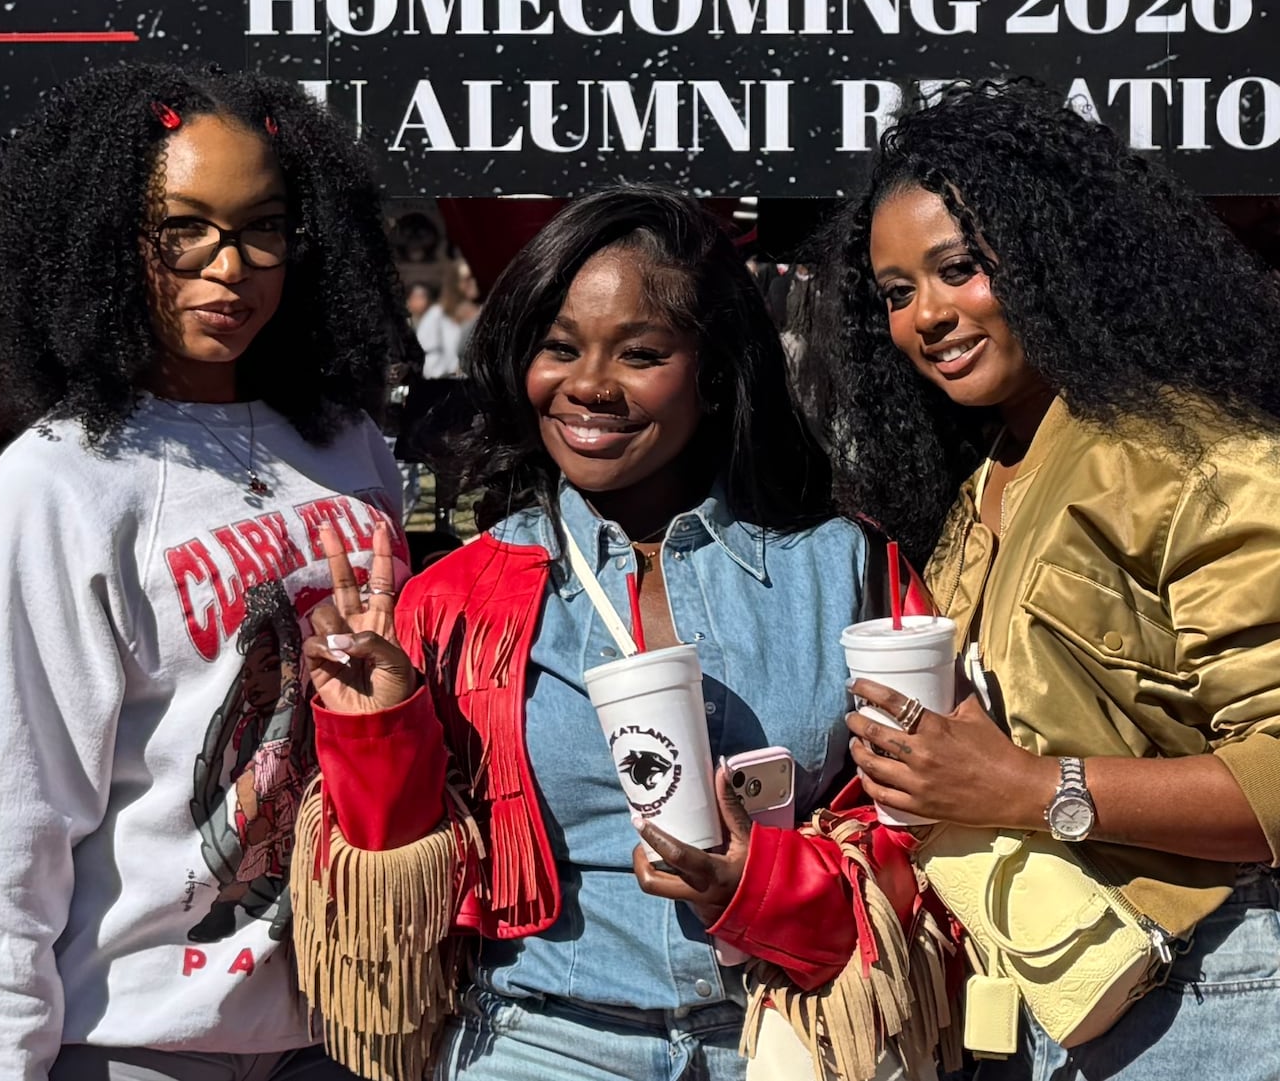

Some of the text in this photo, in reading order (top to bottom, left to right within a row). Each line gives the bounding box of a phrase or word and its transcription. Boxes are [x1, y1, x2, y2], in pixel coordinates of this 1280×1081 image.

[387, 79, 793, 152] ALUMNI
[164, 510, 308, 664] CLARK
[619, 725, 679, 761] ATLANTA
